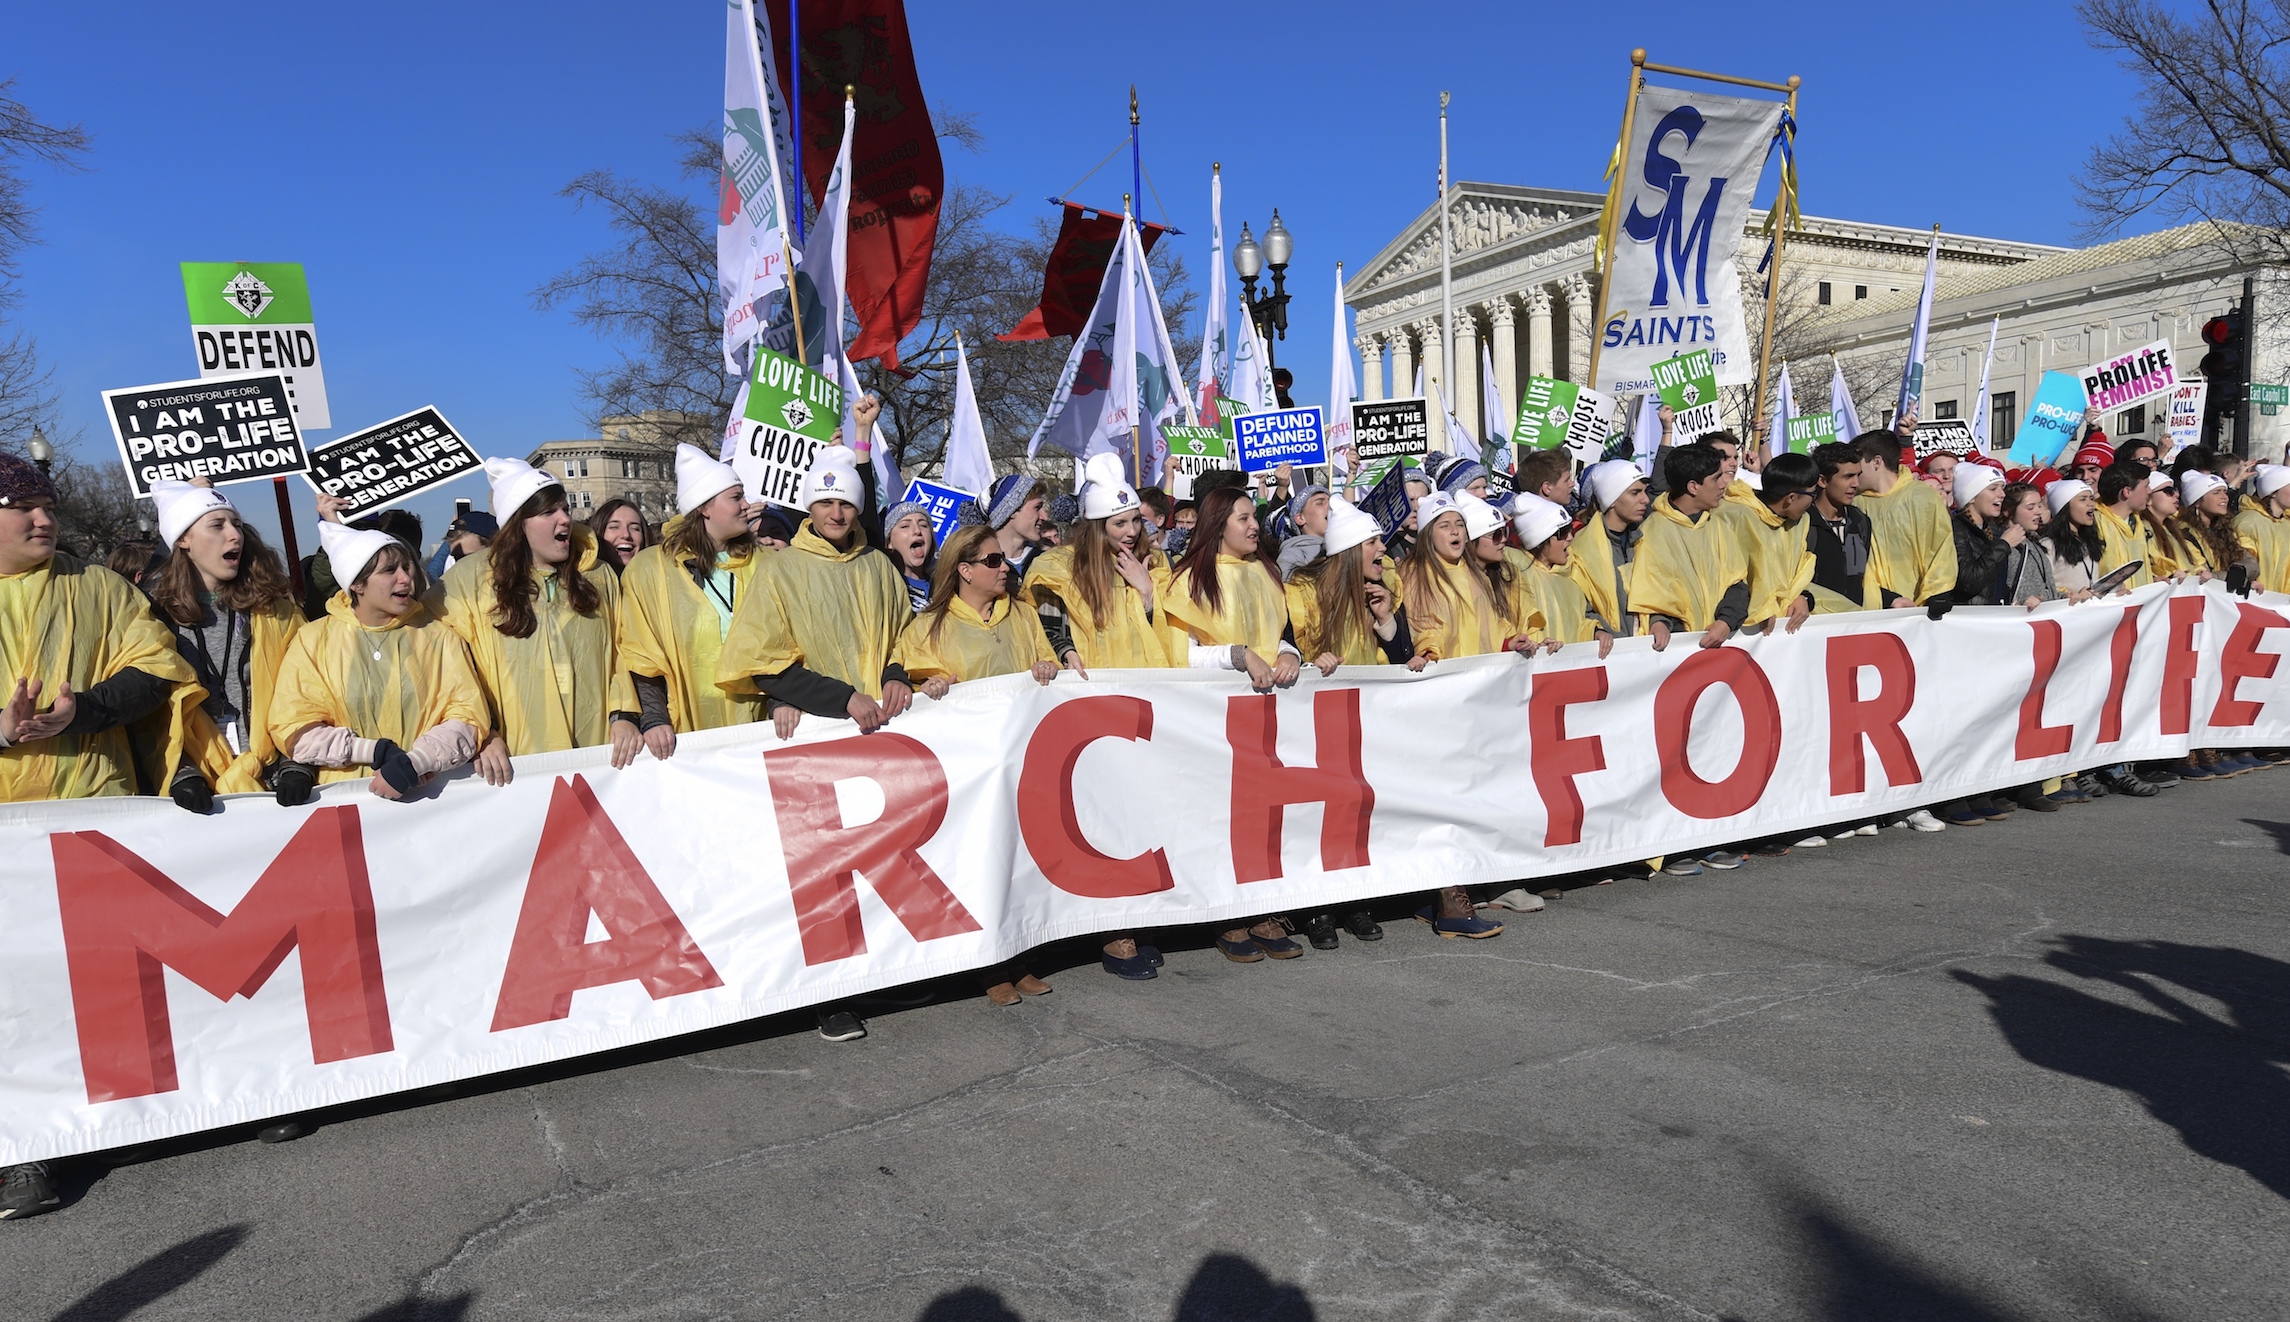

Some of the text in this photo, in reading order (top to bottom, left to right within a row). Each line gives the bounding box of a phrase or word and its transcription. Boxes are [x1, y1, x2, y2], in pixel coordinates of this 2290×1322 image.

[851, 166, 917, 205] amily
[1622, 105, 1728, 308] SM
[1603, 315, 1716, 347] SAINTS
[197, 330, 315, 369] DEFEND
[2110, 355, 2134, 369] AM
[2141, 348, 2152, 357] A
[758, 352, 841, 415] LOVE LIFE
[1615, 380, 1656, 391] BISMAR
[1654, 353, 1712, 389] LOVE LIFE
[2085, 348, 2171, 395] PROLIFE
[2089, 365, 2174, 409] FEMINIST
[149, 386, 260, 408] STUDENTSFORLIFE.ORG
[1215, 399, 1234, 417] LOVE
[1516, 379, 1554, 443] LOVE LIFE
[2173, 401, 2195, 414] KILL
[2250, 386, 2261, 400] East
[2262, 387, 2280, 402] Capitol
[2263, 404, 2275, 414] 100
[129, 397, 277, 432] I AM THE
[1241, 413, 1316, 435] DEFUND
[1358, 412, 1421, 427] I AM THE
[1563, 395, 1597, 450] CHOOSE
[1589, 416, 1609, 444] LIFE
[1789, 416, 1833, 441] LOVE LIFE
[2036, 402, 2084, 424] PRO-LIFE
[128, 417, 294, 462] PRO-LIFE
[329, 420, 420, 458] STUDENTSFORLIFE.ORG
[750, 424, 826, 472] CHOOS
[1164, 426, 1219, 439] LOVE LIFE
[1243, 428, 1317, 449] PLANNED
[1356, 424, 1426, 443] PRO-LIFE
[1358, 440, 1425, 456] GENERATION
[1913, 438, 1974, 450] PLANNED
[141, 446, 297, 485] GENERATION
[316, 424, 439, 478] I AM THE
[321, 434, 461, 496] PRO-LIFE
[1245, 442, 1318, 460] PARENTHOOD
[343, 452, 471, 509] GENERATION
[761, 465, 803, 504] LIFE
[1386, 467, 1406, 521] DEFUND
[51, 595, 2290, 1102] MARCH FOR LIFE
